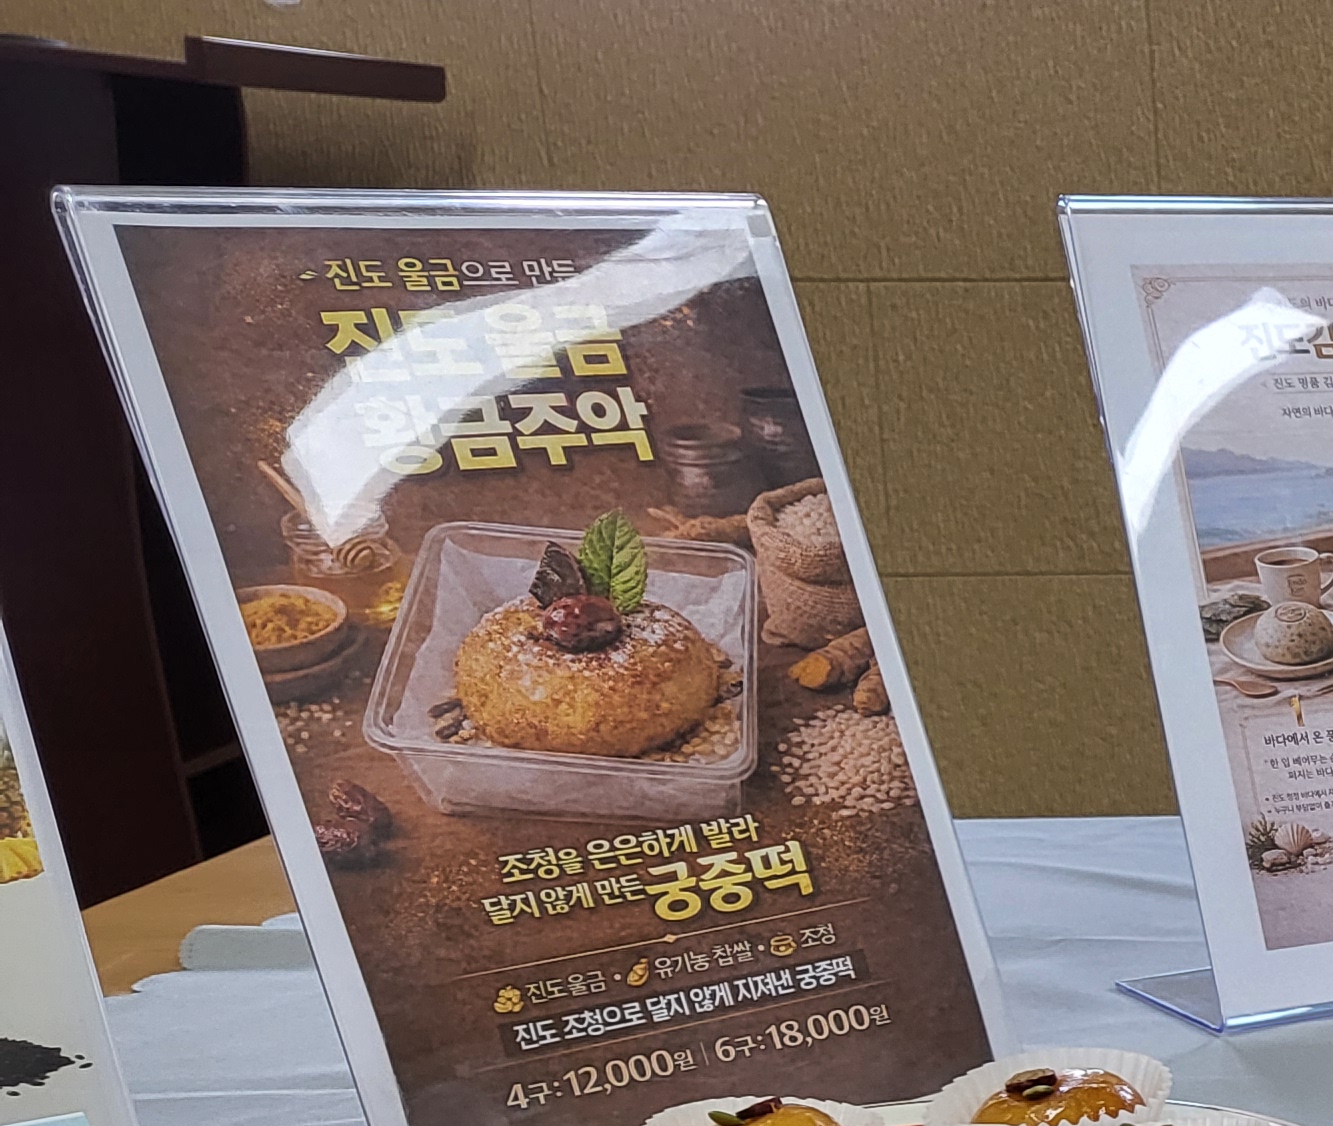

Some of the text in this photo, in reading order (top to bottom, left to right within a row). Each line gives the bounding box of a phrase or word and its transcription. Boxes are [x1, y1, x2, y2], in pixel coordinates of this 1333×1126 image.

[324, 259, 393, 290] 진도
[397, 257, 519, 290] 울금으로
[320, 303, 629, 382] 진도 울금
[1273, 377, 1295, 390] 진도
[1298, 376, 1320, 389] 명품
[1282, 405, 1312, 419] 자연의
[1314, 404, 1333, 417] 바다
[354, 387, 654, 475] 황금주악
[1263, 731, 1310, 749] 바다에서
[1312, 730, 1324, 745] 온
[481, 840, 814, 925] 달지 않게 만든 궁중떡
[499, 814, 759, 883] 조청을 은은하게 발라
[525, 922, 836, 1004] 진도울금 유기농 찹쌀 조청
[513, 956, 857, 1051] 진도 조청으로 달지 않게 지져낸 궁중떡
